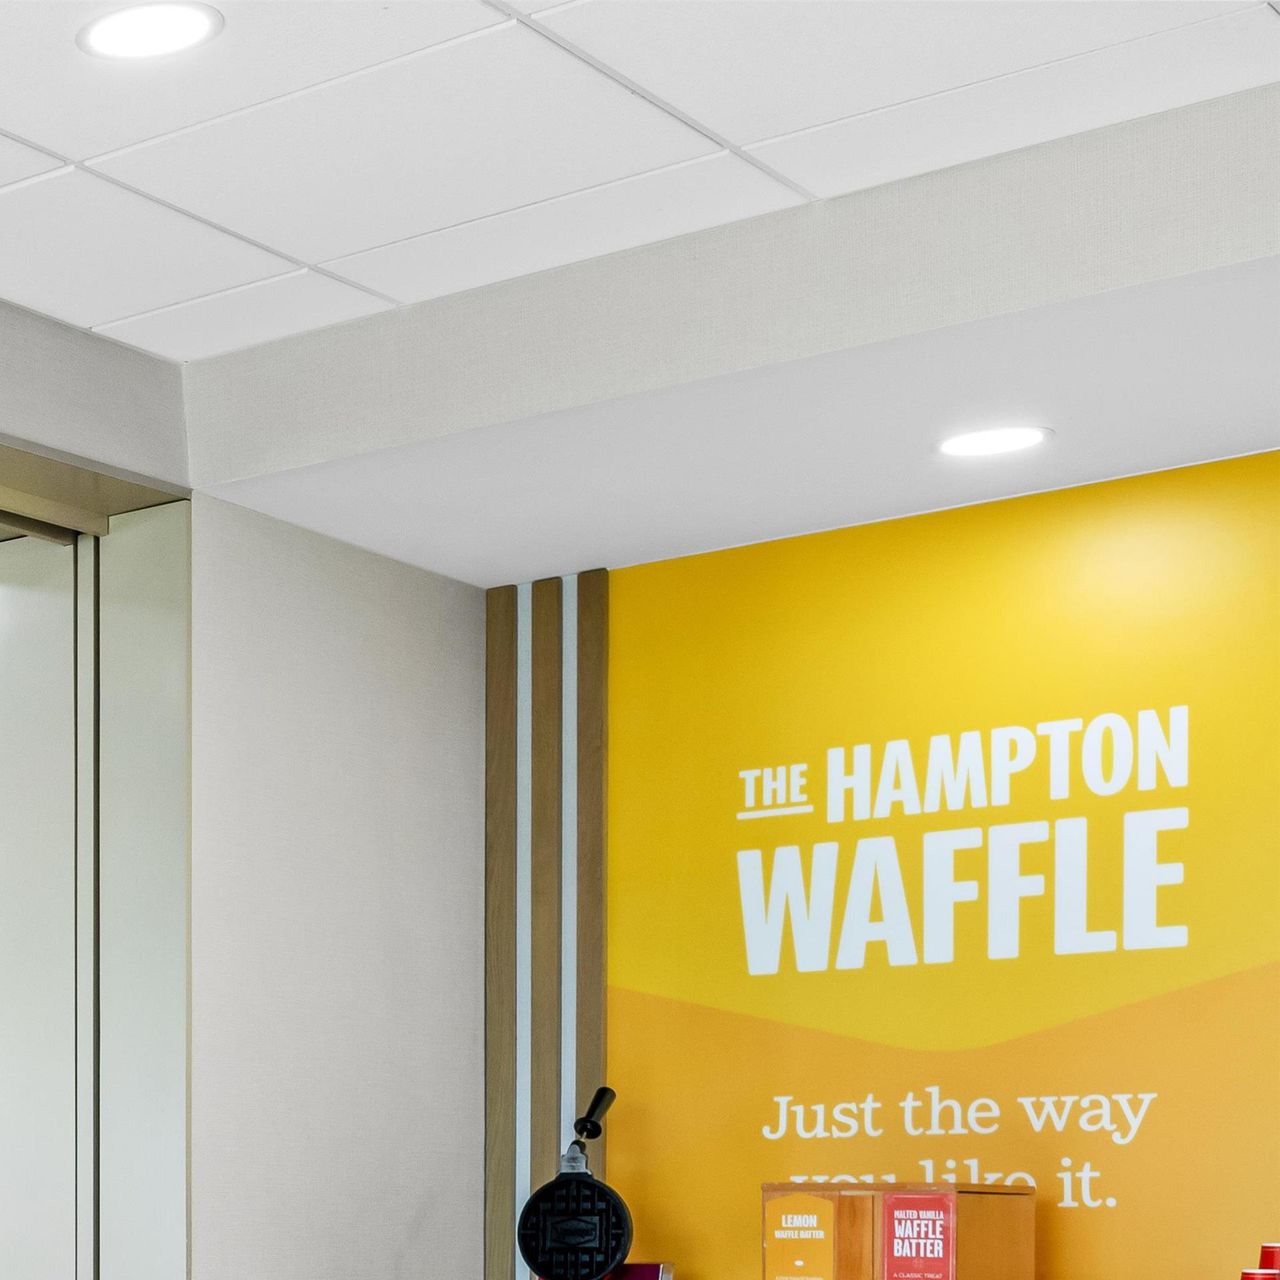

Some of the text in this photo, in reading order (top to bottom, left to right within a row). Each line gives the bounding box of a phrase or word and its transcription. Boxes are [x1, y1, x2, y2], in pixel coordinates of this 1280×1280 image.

[738, 704, 1189, 824] THE HAMPTON
[736, 806, 1190, 977] WAFFLE
[761, 1085, 1158, 1145] Just the way
[1056, 1156, 1117, 1208] it.
[781, 1214, 817, 1228] LEMON
[893, 1220, 944, 1239] WAFFLE
[893, 1238, 944, 1259] BATTER
